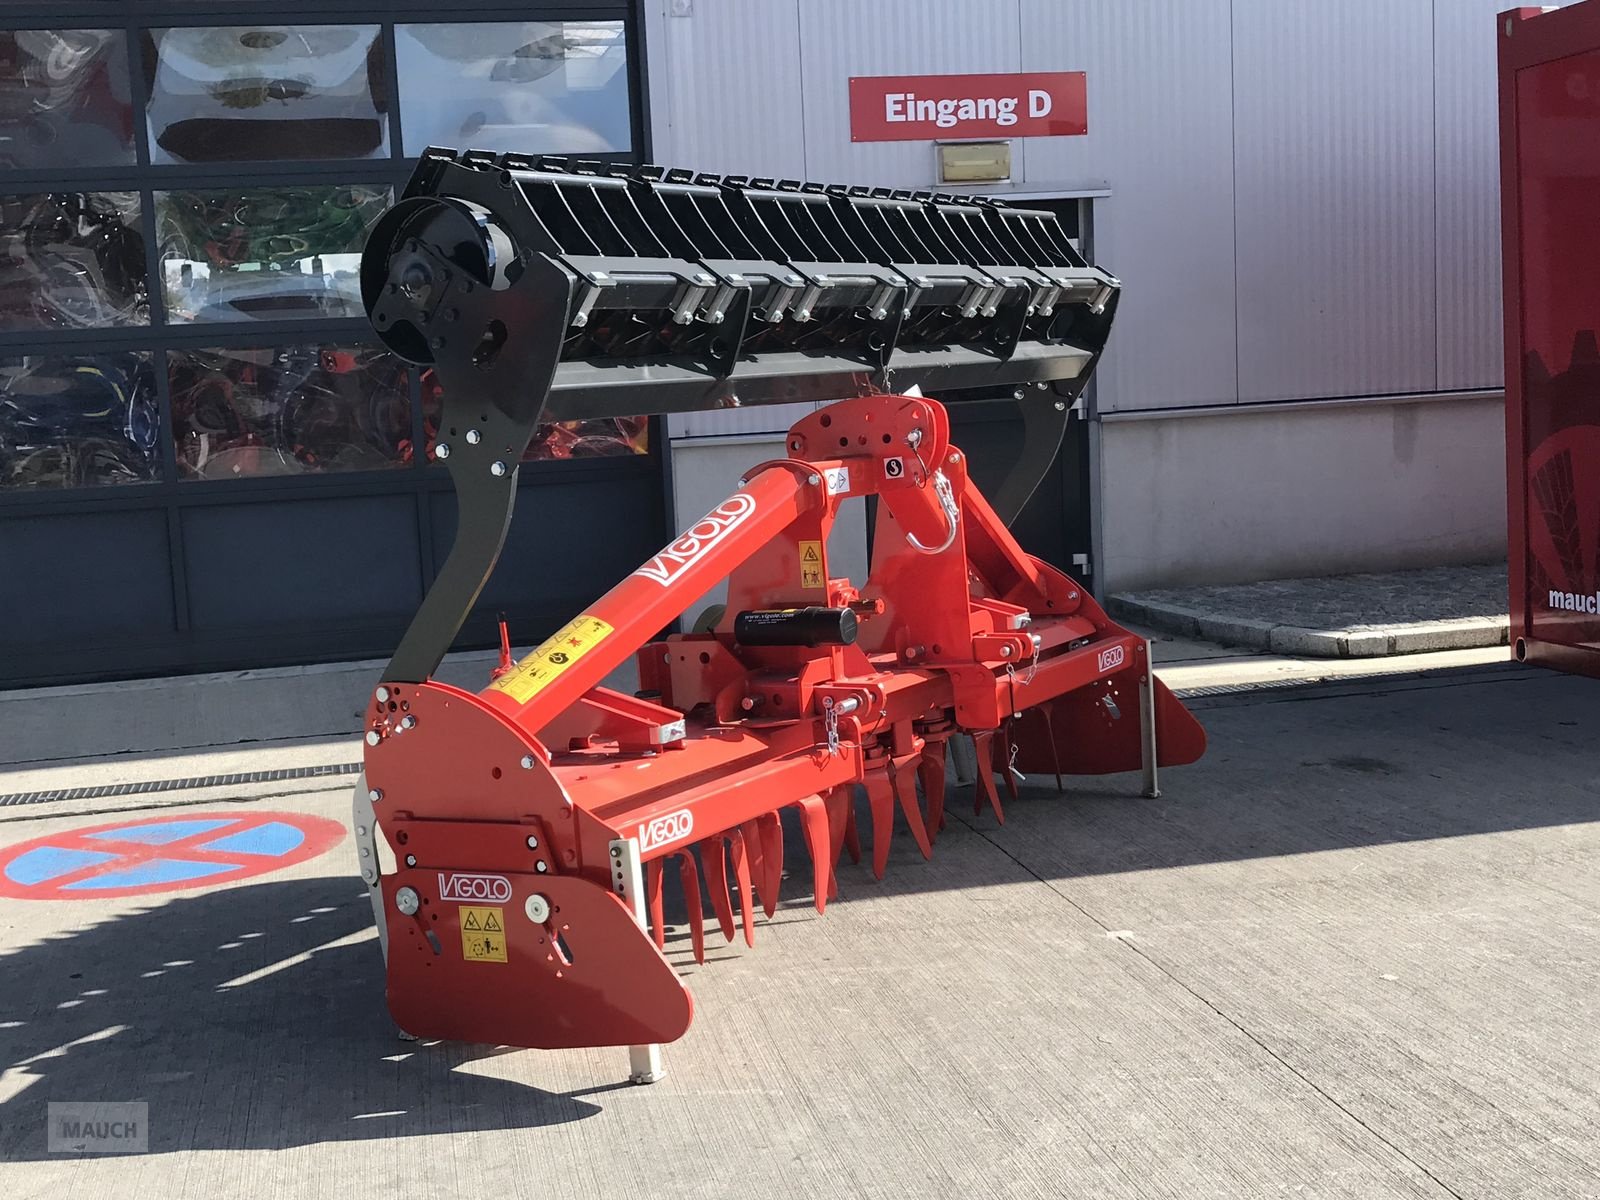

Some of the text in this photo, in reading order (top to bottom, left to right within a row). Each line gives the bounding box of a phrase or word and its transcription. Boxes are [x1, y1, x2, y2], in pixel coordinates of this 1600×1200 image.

[885, 89, 1052, 127] Eingang D
[632, 493, 756, 587] VIGOLO
[639, 808, 693, 853] VIGOLO
[438, 873, 512, 903] VIGOLO
